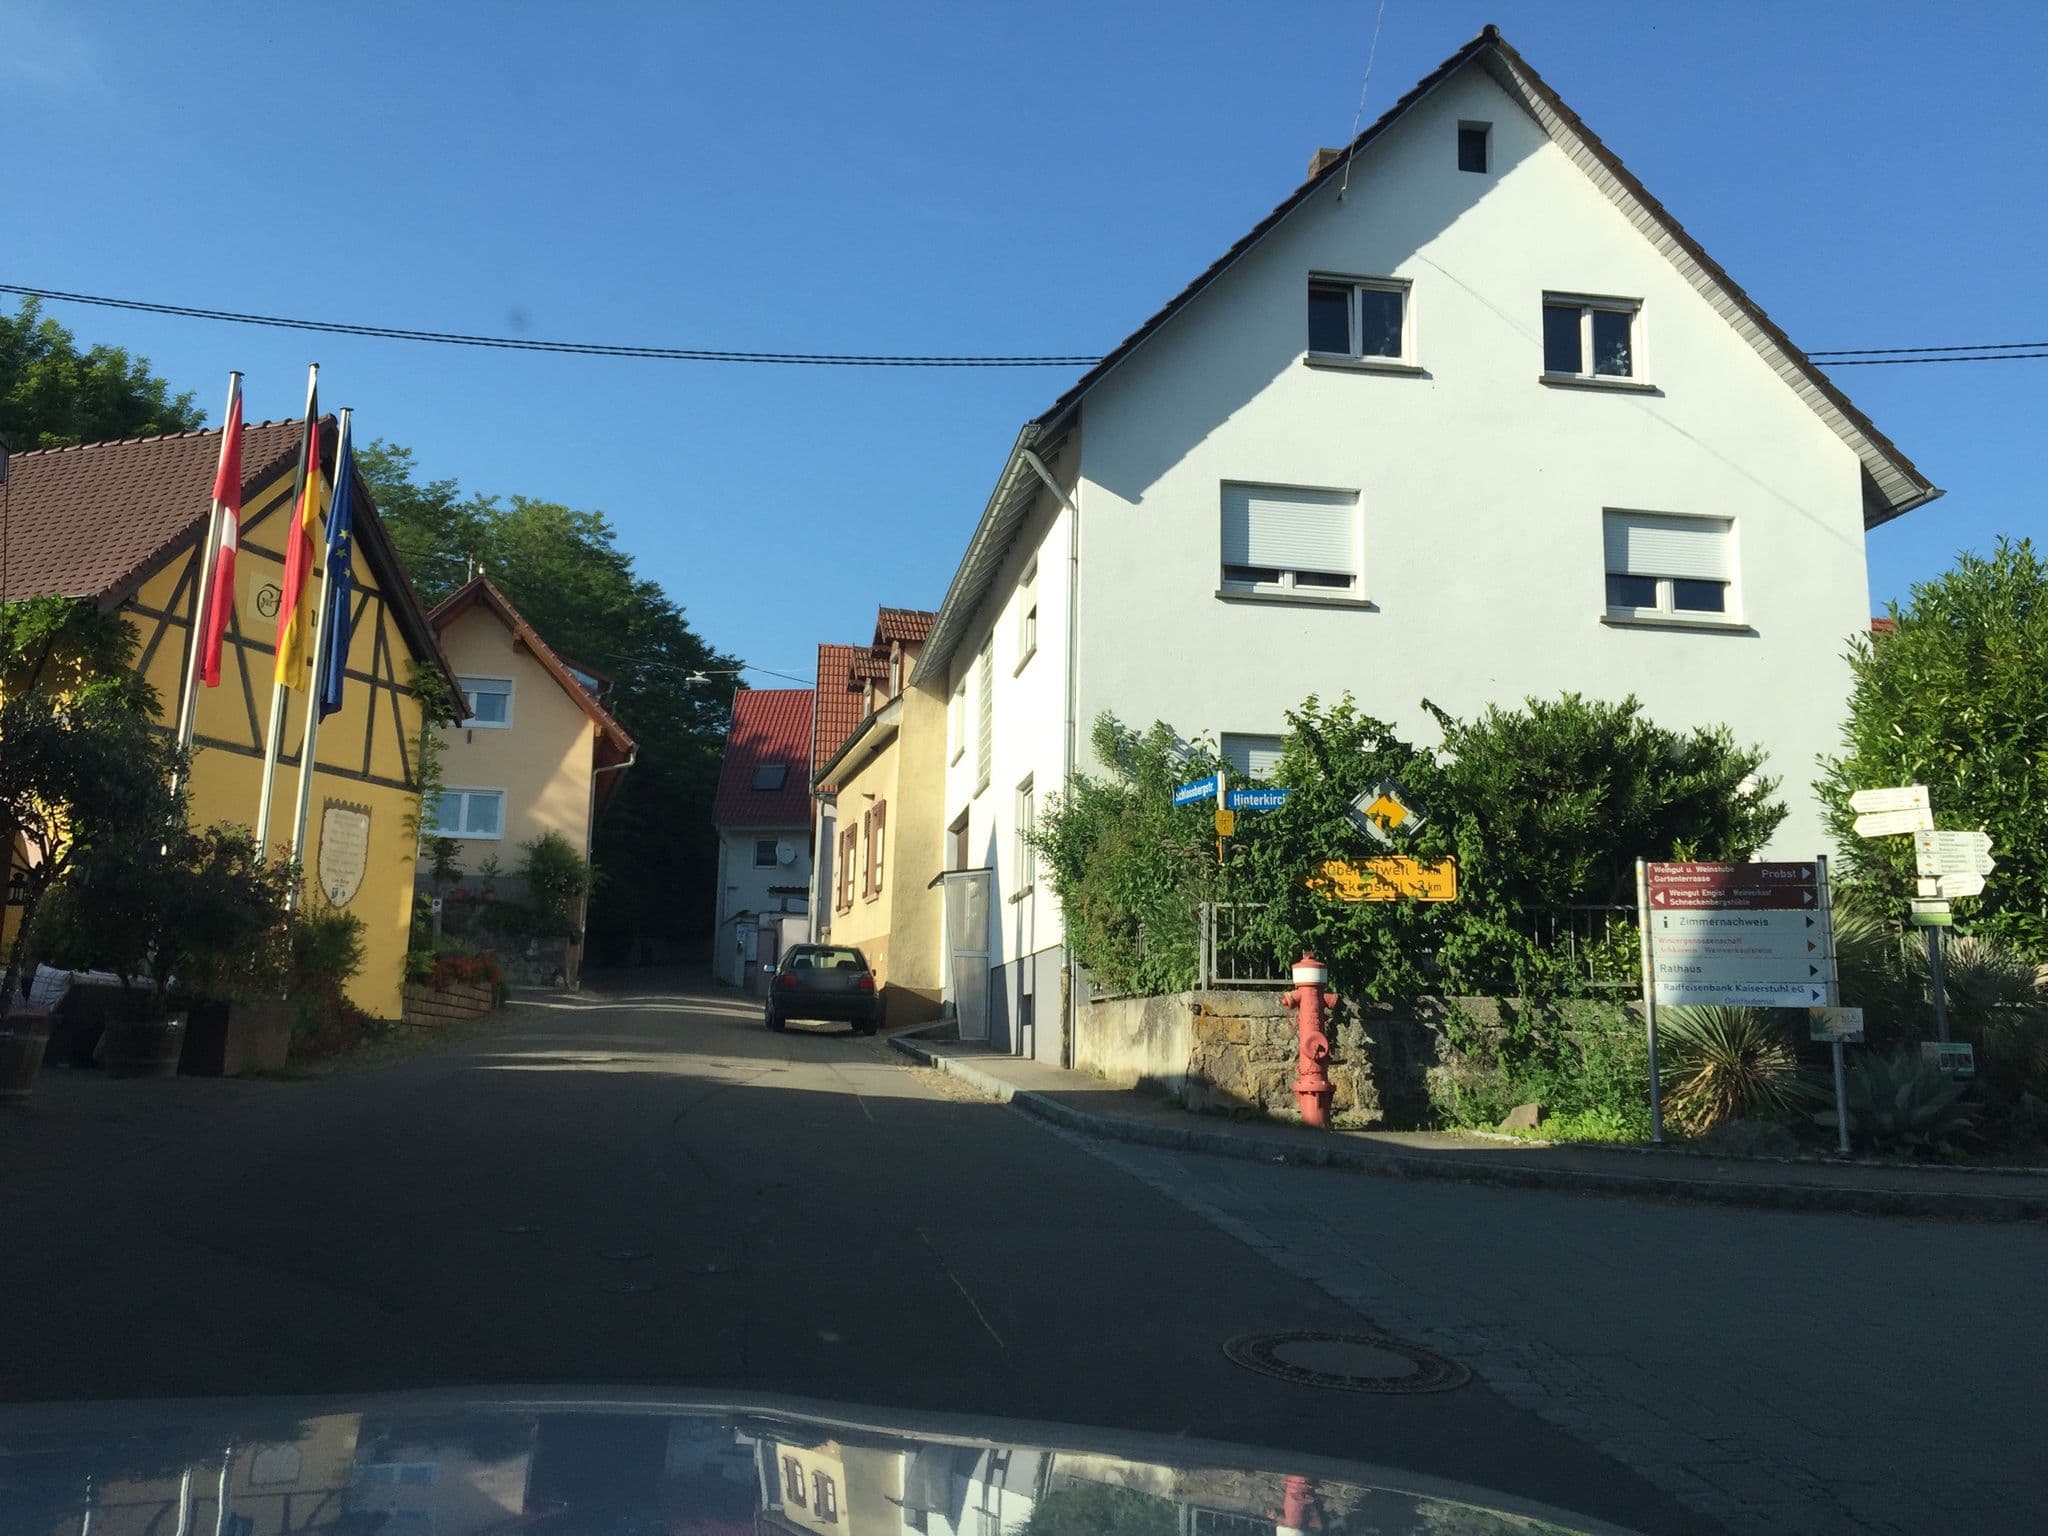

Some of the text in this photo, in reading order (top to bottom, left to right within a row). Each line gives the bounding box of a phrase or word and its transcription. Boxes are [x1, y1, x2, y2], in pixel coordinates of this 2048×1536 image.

[1326, 863, 1409, 876] Obertweil
[1654, 866, 1684, 875] Weingut
[1761, 869, 1797, 879] Probst
[1654, 875, 1711, 883] Gartenterrasse
[1428, 881, 1442, 892] km
[1669, 889, 1700, 898] Weingut
[1679, 916, 1769, 928] Zimmernachweis
[1659, 964, 1703, 974] Rathaus
[1663, 983, 1805, 994] Raiffeisenbank Kaiserstuhl eG
